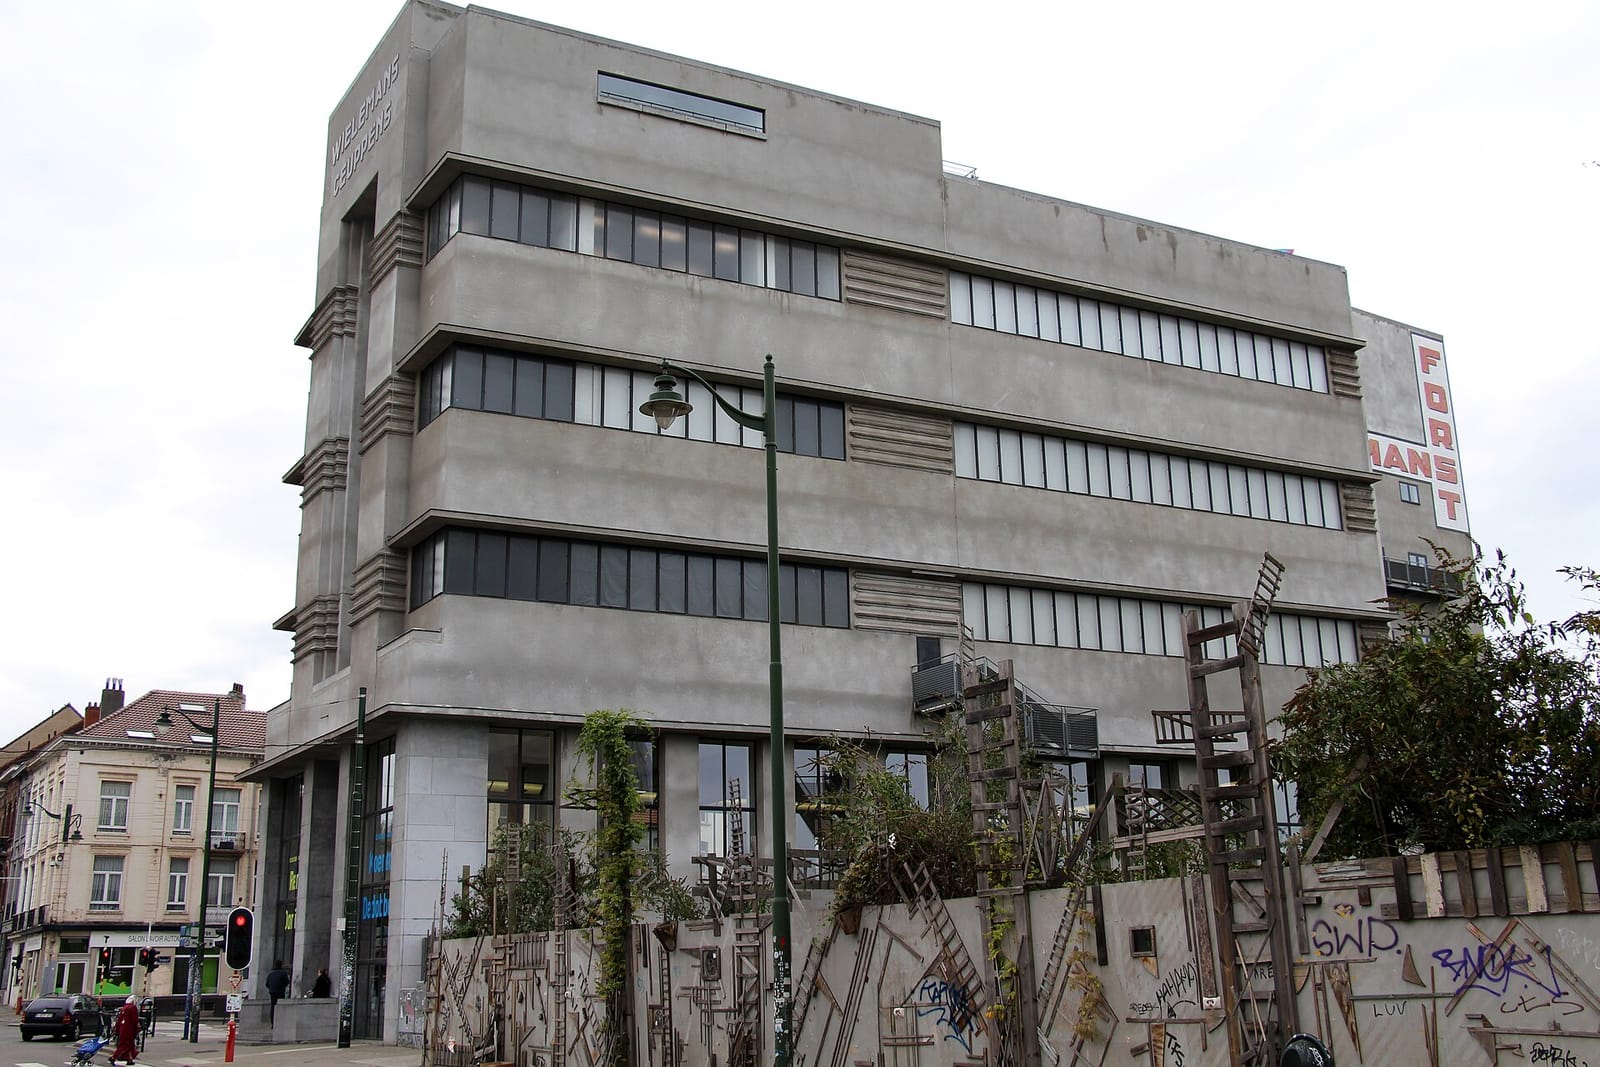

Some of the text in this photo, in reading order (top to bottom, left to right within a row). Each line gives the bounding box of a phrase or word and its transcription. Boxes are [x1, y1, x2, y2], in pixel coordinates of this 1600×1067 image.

[332, 53, 400, 167] WIELEMANS
[332, 100, 393, 198] CEUPPENS
[1418, 345, 1461, 521] FORST
[128, 935, 145, 943] SALON
[1373, 1000, 1407, 1018] LUV
